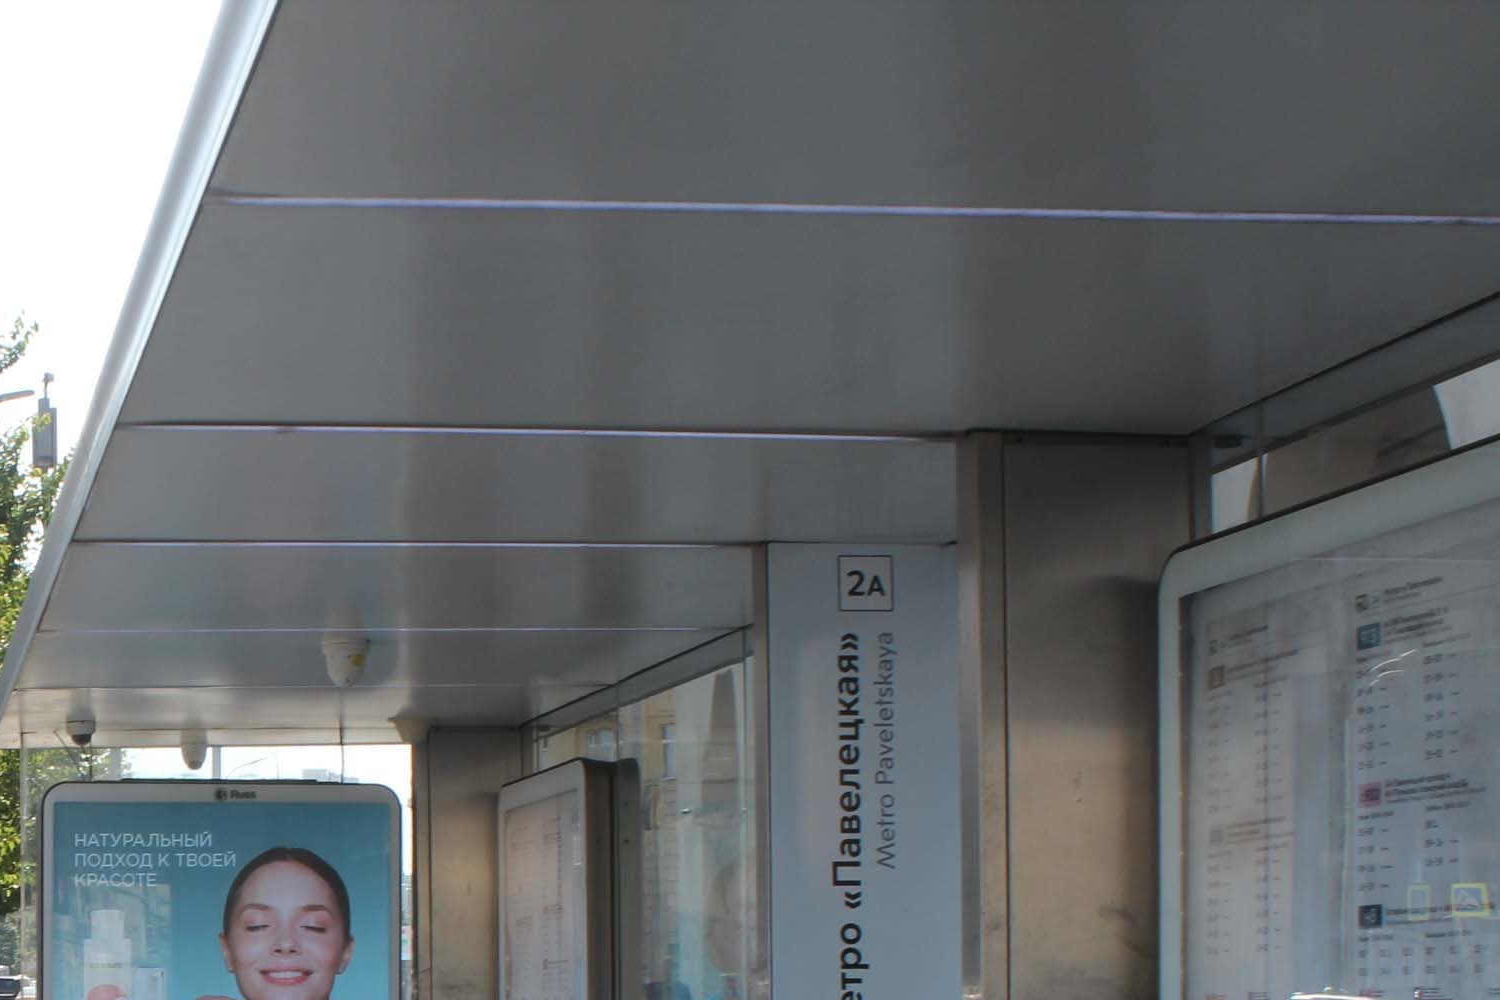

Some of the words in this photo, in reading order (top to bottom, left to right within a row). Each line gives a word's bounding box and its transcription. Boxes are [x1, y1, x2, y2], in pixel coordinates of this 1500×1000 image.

[873, 632, 898, 785] Paveletskaya
[831, 632, 864, 909] «Павелецкая»
[74, 831, 213, 848] НАТУРАЛЬНЫЙ
[875, 793, 896, 869] Metro
[74, 853, 153, 869] ПОДХОД
[157, 853, 171, 867] К
[174, 851, 237, 868] ТВОЕЙ
[74, 873, 157, 888] КРАСОТЕ
